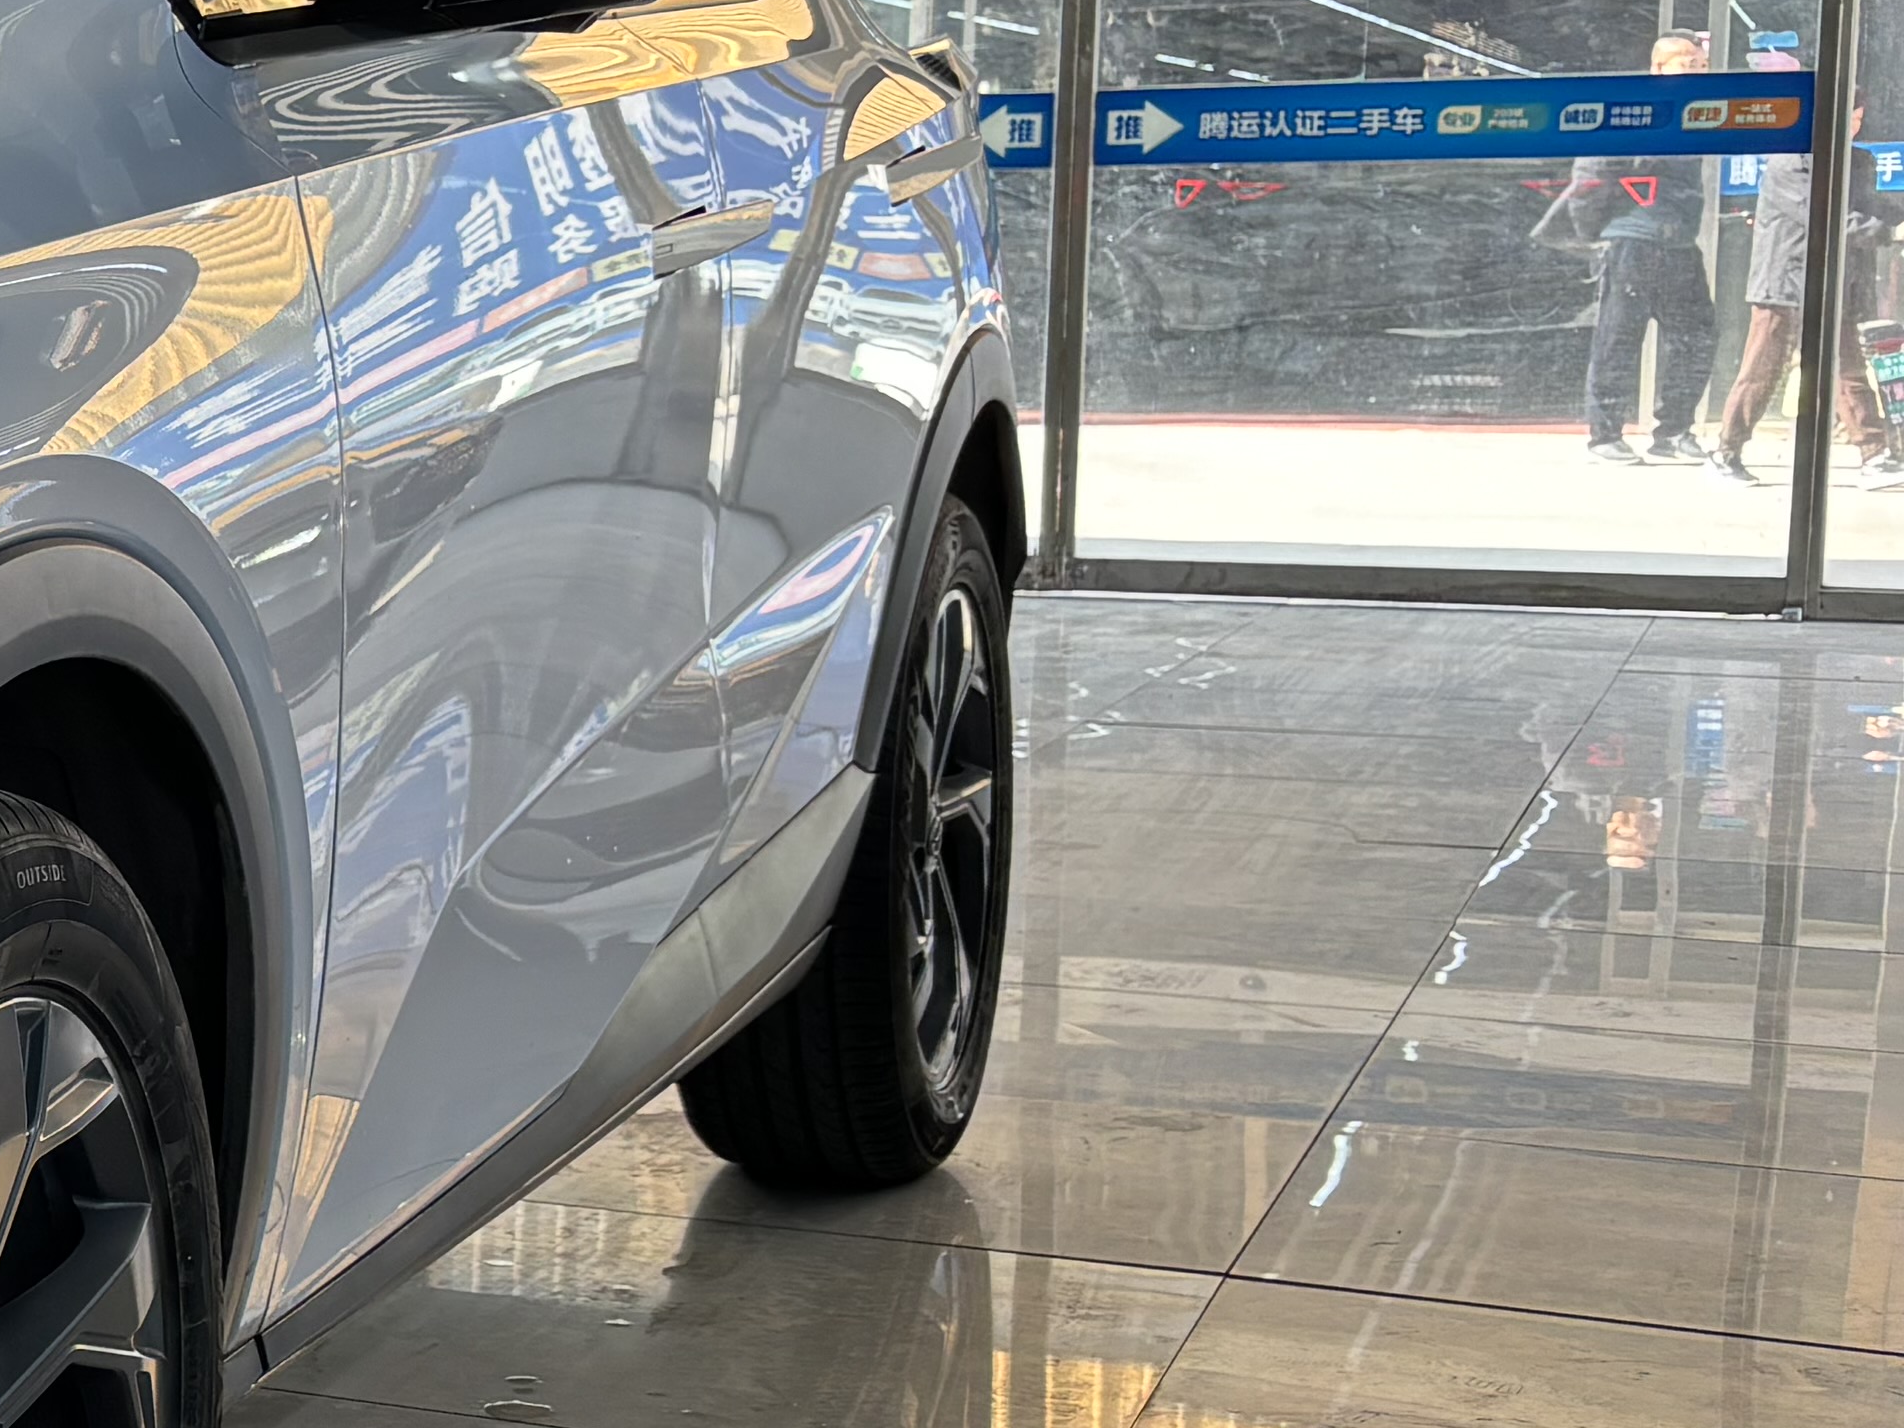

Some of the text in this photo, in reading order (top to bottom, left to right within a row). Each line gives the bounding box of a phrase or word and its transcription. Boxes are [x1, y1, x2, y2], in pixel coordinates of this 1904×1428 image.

[1008, 119, 1036, 143] 推
[1114, 115, 1142, 140] 推
[1198, 106, 1425, 139] 腾运认证二手车
[15, 863, 68, 889] OUTSIDE
